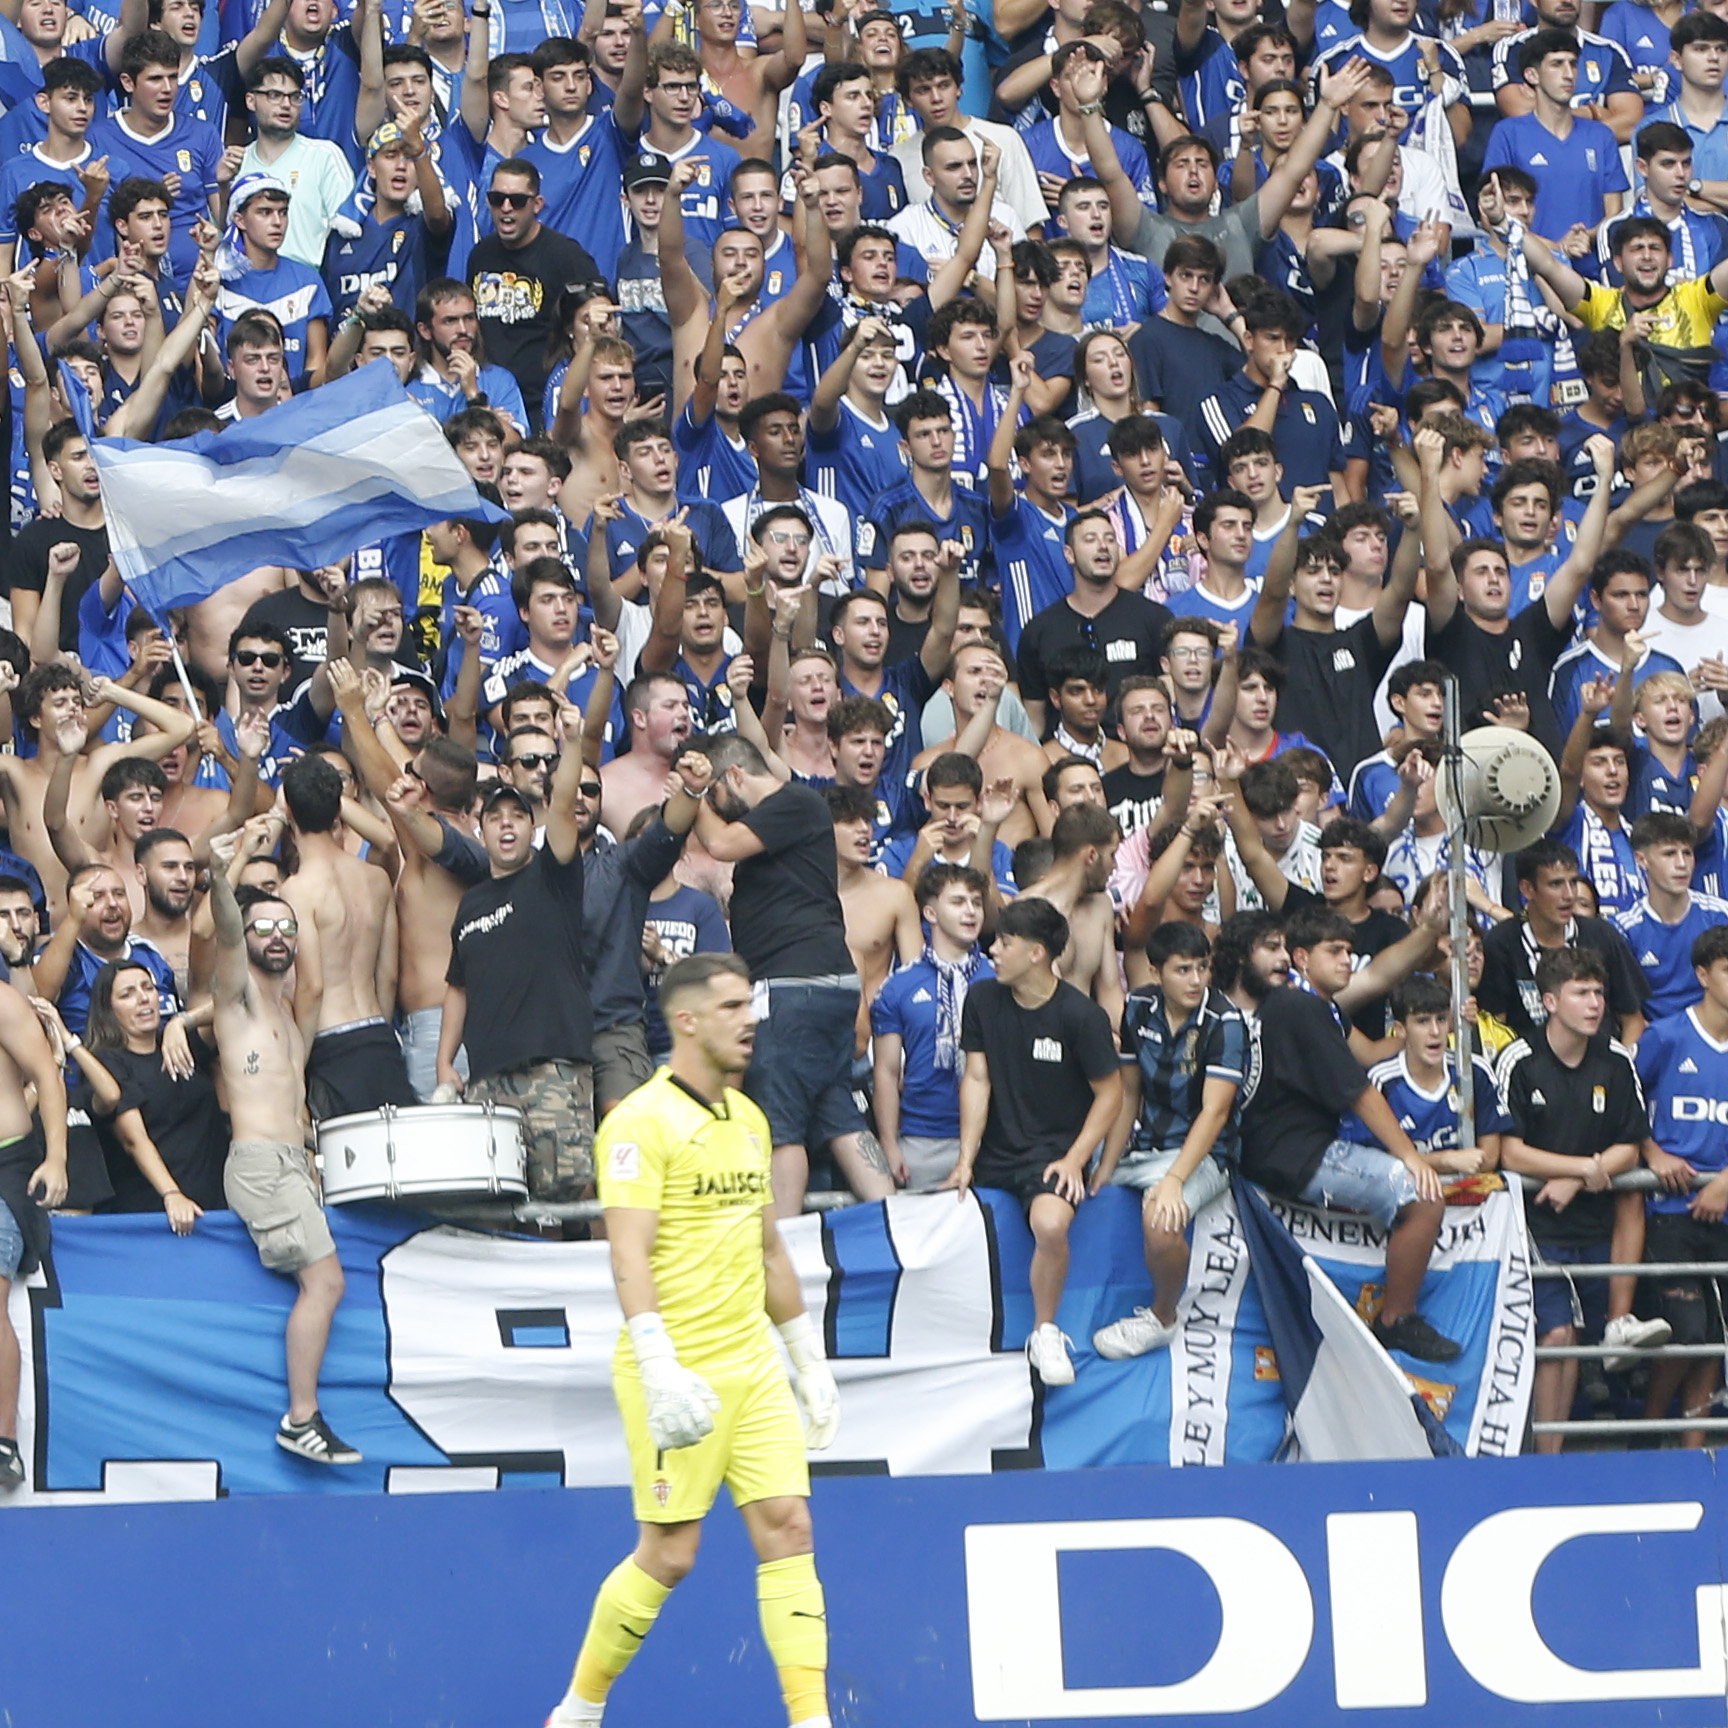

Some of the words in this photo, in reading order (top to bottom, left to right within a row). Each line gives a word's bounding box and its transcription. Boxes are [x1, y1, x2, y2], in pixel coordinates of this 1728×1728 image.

[648, 919, 696, 945] VIEDO
[1194, 1300, 1224, 1384] MUY
[1489, 1252, 1526, 1415] INVICTA
